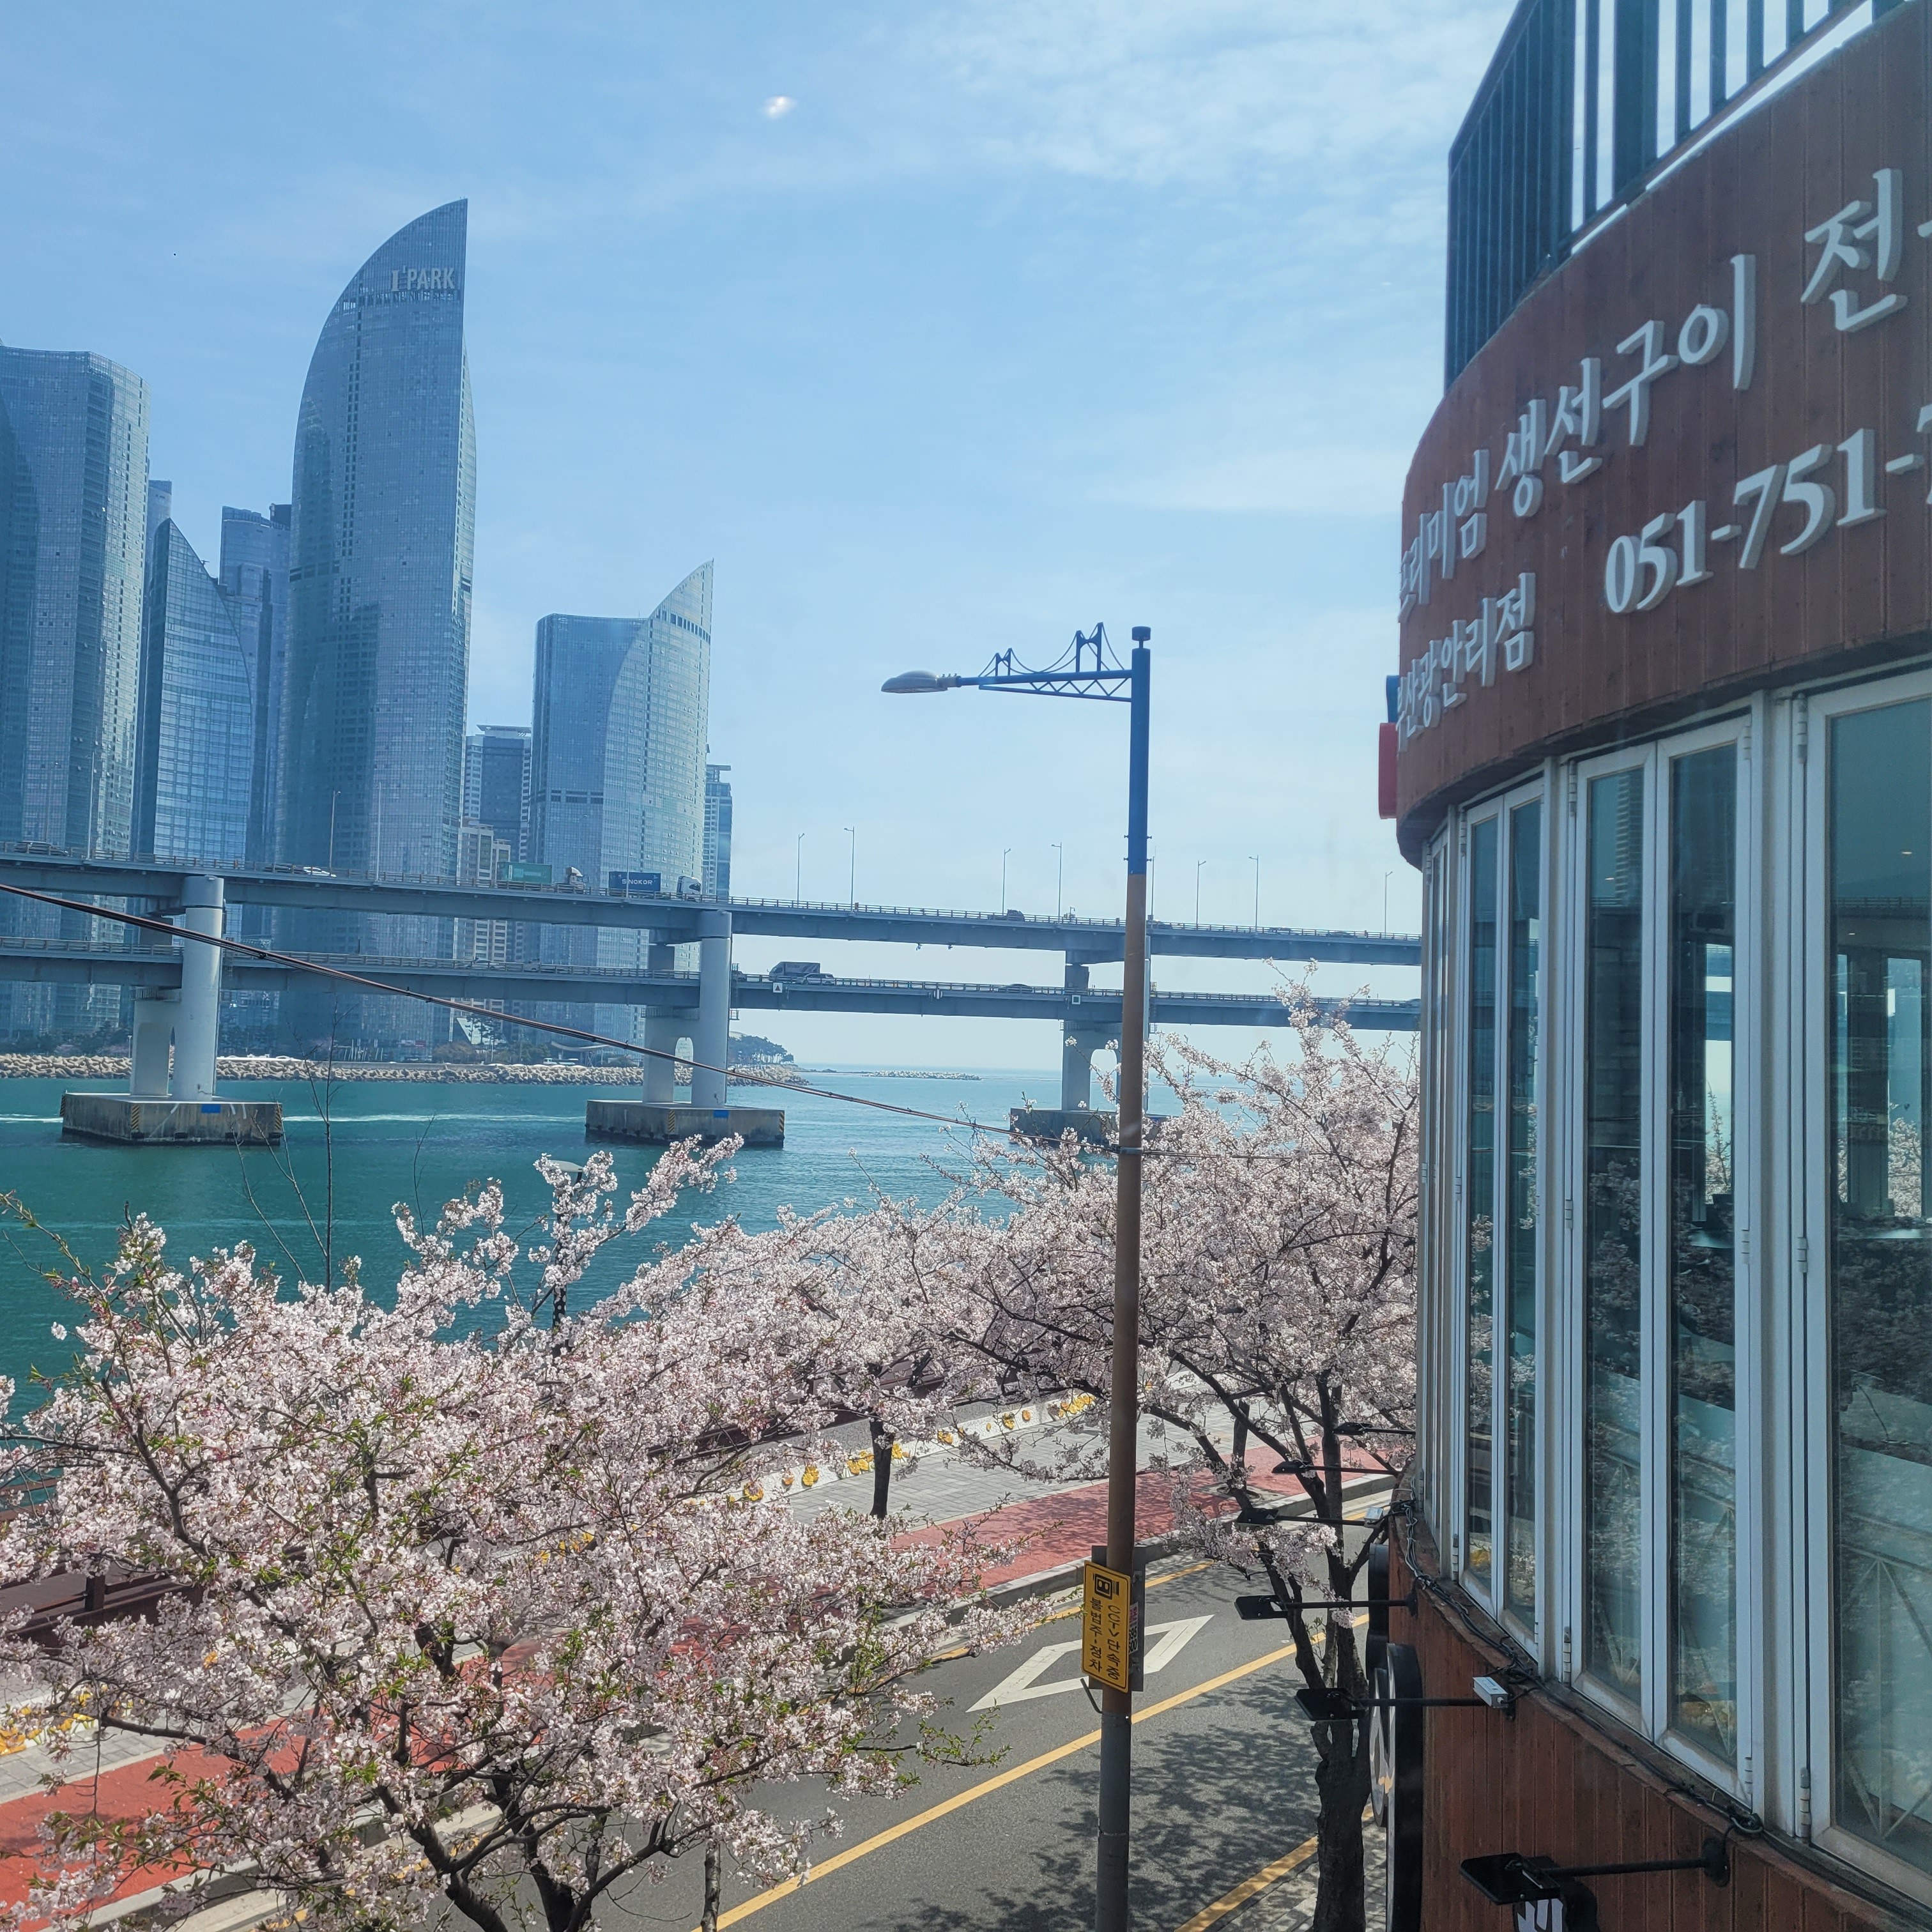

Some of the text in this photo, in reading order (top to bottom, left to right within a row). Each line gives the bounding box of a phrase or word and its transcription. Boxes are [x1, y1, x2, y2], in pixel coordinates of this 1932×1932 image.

[1494, 254, 1757, 518] 생선구이
[1801, 167, 1932, 333] 전
[1395, 571, 1537, 753] 부산광안리점
